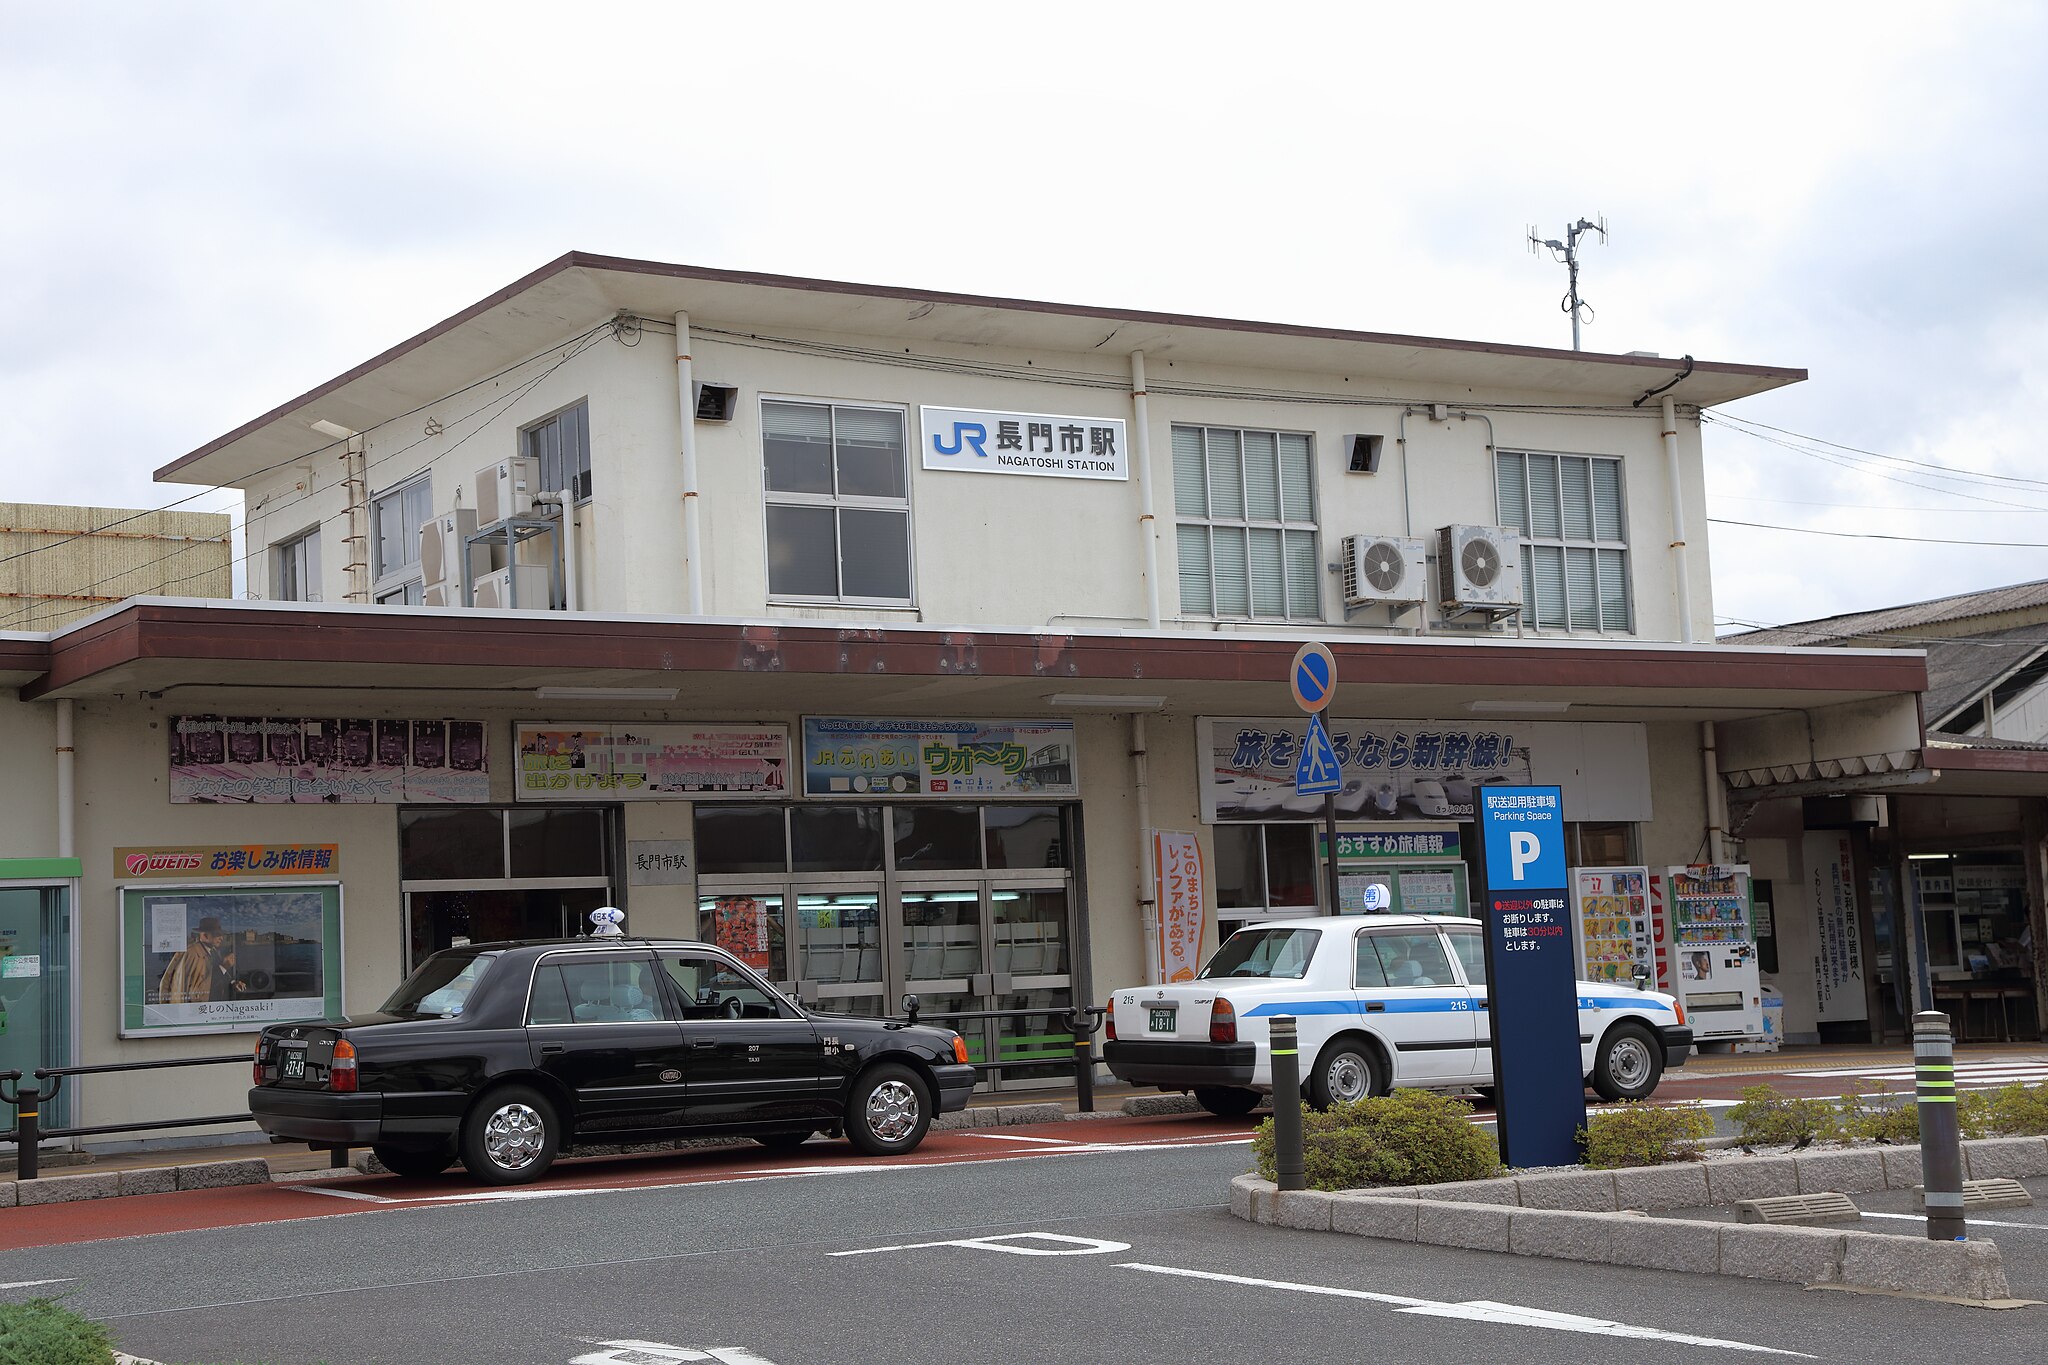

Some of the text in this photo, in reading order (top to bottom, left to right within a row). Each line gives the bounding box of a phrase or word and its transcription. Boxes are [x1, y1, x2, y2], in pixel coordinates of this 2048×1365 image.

[934, 421, 988, 457] JR
[996, 420, 1117, 457] 長門市駅
[998, 455, 1116, 472] NAGATOSHI STATION
[1230, 730, 1513, 769] 旅をるなら新幹線!
[1487, 796, 1556, 808] 駅送迎用駐車場
[1494, 811, 1552, 822] Parking Space
[1337, 834, 1444, 855] おすすめ旅情報
[210, 849, 333, 870] お楽しみ旅情報
[634, 853, 688, 871] 長門市駅
[1509, 831, 1541, 881] P
[1183, 845, 1199, 943] このまちには
[1168, 844, 1185, 962] レノファがある。
[1502, 899, 1565, 911] 送迎以外の駐車は
[1503, 913, 1554, 924] お断りします。
[1503, 926, 1564, 938] 駐車は30分以内
[1505, 941, 1541, 951] とします。
[1123, 996, 1134, 1005] 215
[1450, 1000, 1468, 1011] 215
